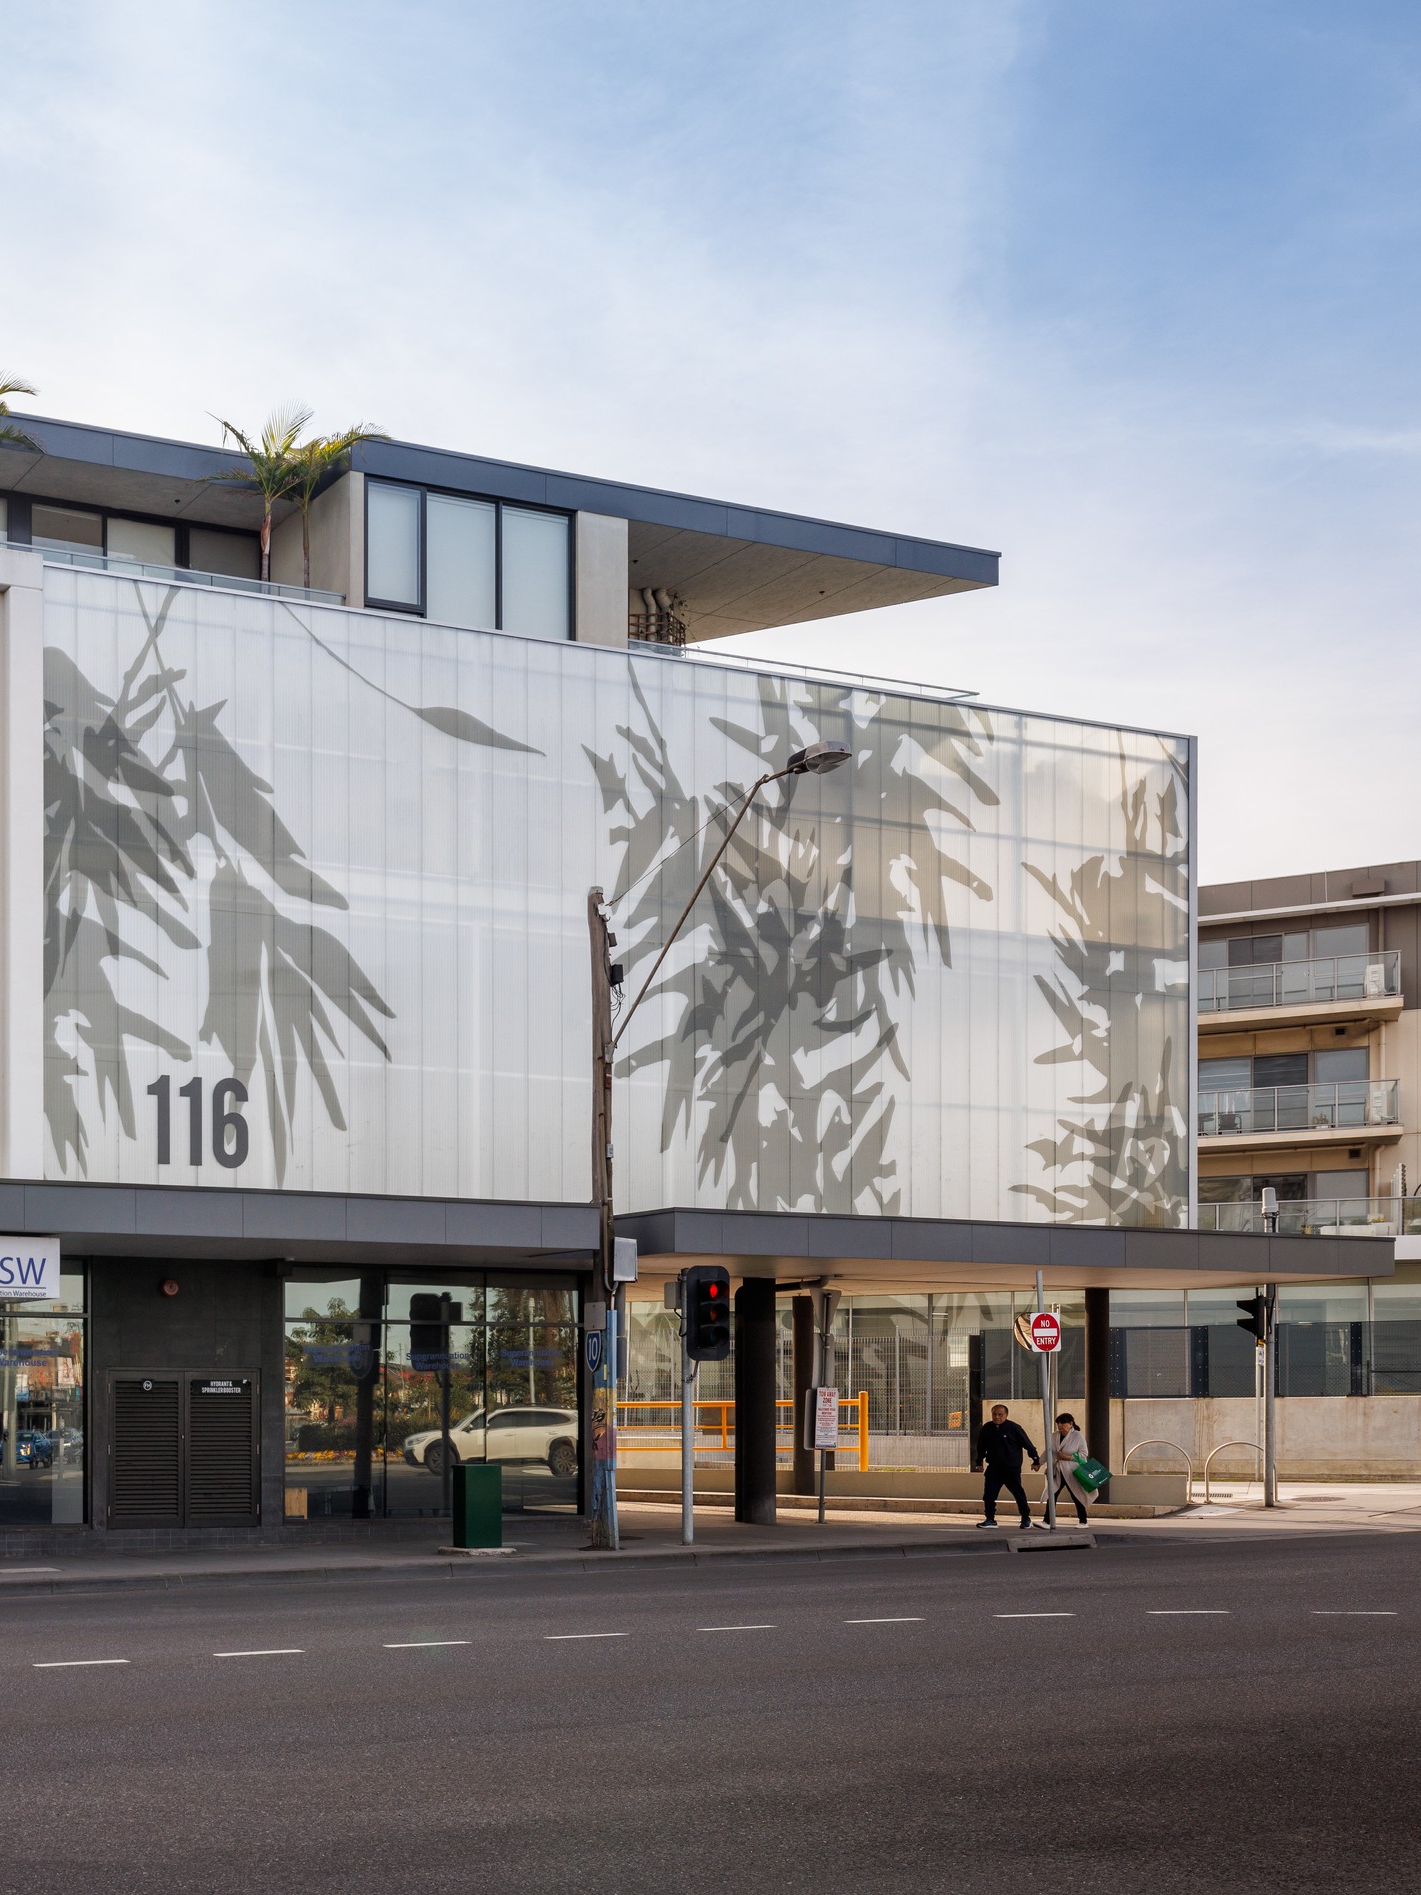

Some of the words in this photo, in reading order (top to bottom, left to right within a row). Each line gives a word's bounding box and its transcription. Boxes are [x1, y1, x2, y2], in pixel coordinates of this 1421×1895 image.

[147, 1074, 249, 1169] 116
[0, 1256, 47, 1285] SW
[12, 1290, 47, 1298] Warehouse
[1040, 1319, 1050, 1328] NO
[1036, 1337, 1056, 1345] ENTRY
[588, 1337, 598, 1361] 10
[405, 1351, 470, 1363] Superannuation
